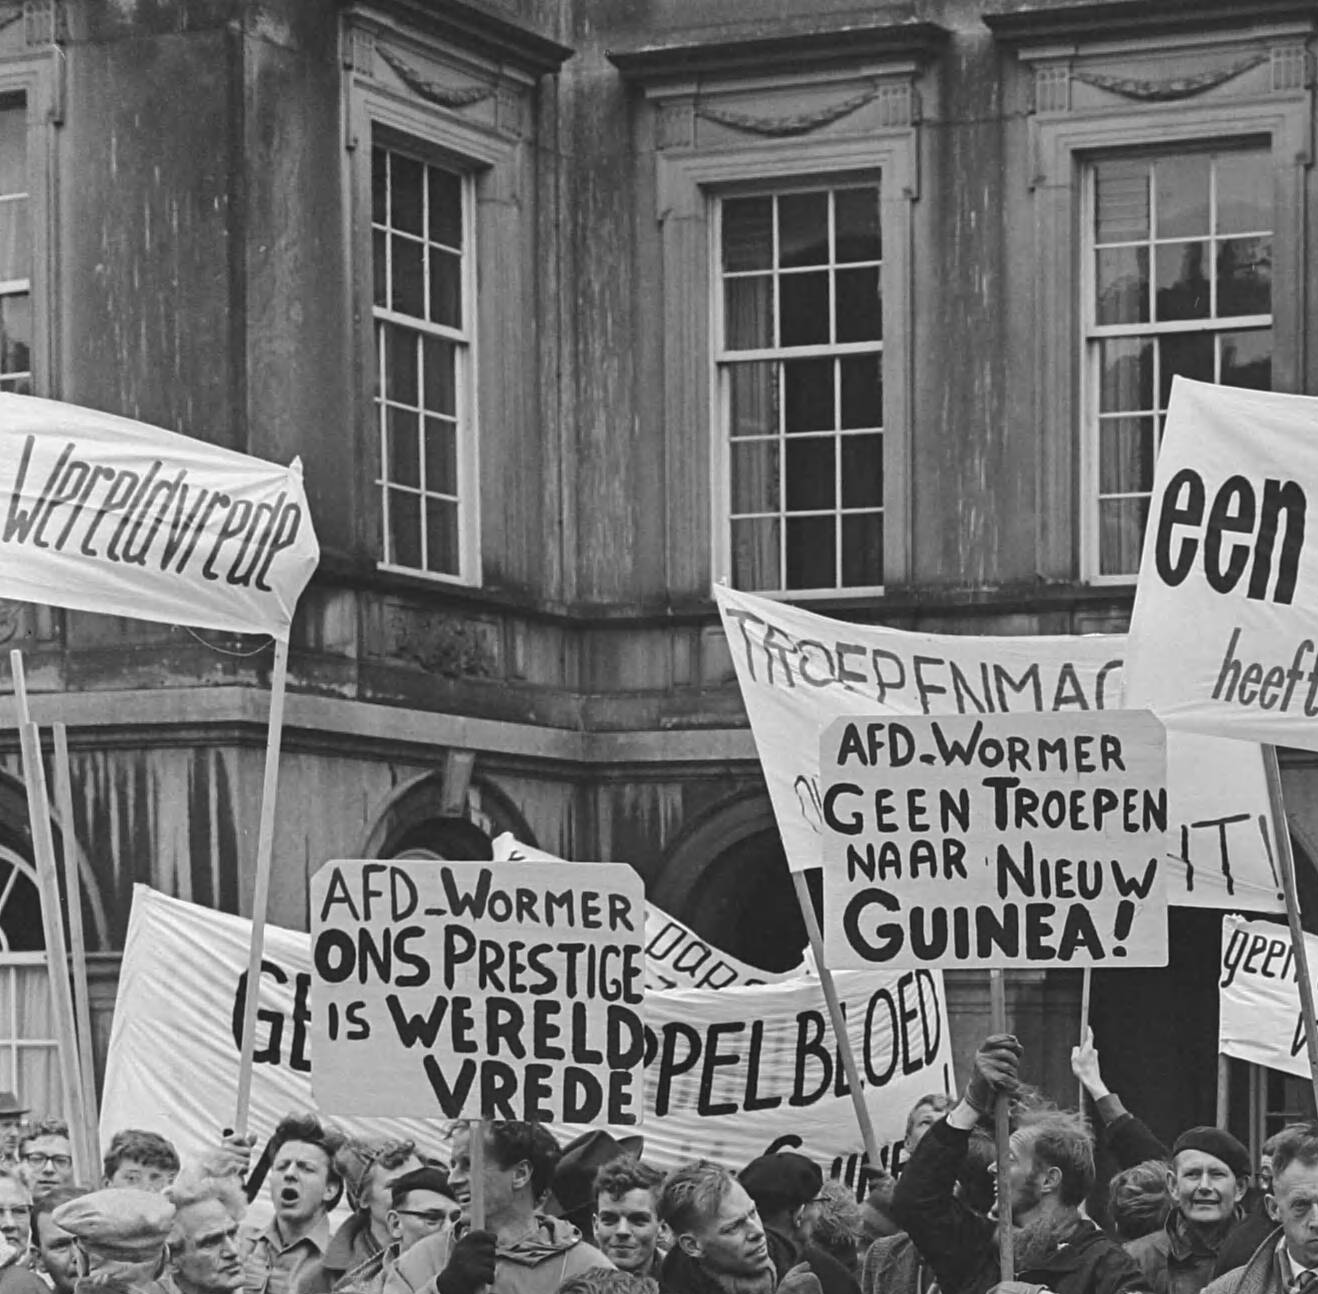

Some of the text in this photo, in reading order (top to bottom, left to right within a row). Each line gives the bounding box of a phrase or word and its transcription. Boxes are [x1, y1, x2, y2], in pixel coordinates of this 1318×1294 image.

[2, 434, 301, 592] Wereldvrede
[1155, 468, 1307, 605] een
[823, 783, 970, 836] GEEN
[983, 777, 1167, 833] TROEPEN
[846, 838, 1157, 901] NAAR NIEUW
[843, 887, 1137, 963] GUINEA!
[314, 924, 644, 1005] ONS PRESTIGE
[328, 994, 645, 1070] IS WERELD
[423, 1054, 637, 1126] VREDE
